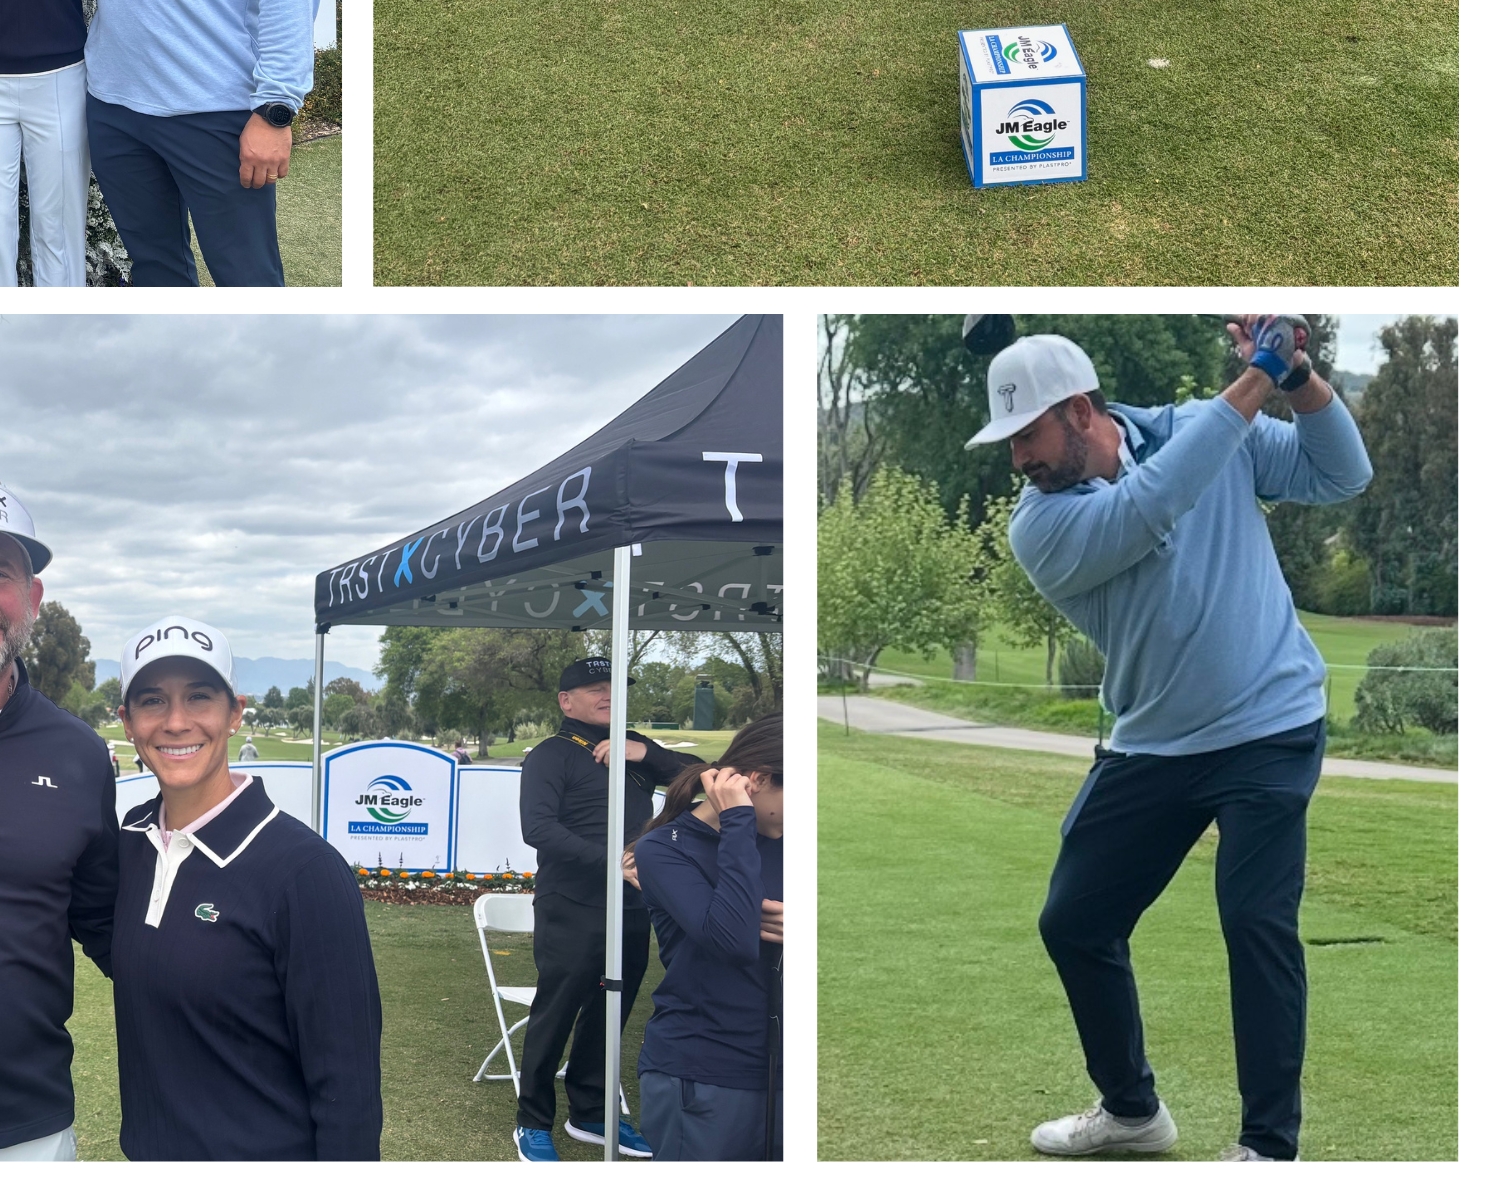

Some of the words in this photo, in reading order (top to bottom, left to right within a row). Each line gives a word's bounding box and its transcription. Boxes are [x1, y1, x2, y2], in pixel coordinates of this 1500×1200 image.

[995, 121, 1020, 135] JM
[1022, 118, 1068, 135] Eagle
[1004, 150, 1072, 162] CHAMPIONSHIP
[135, 625, 214, 661] ping
[355, 794, 378, 806] JM
[380, 794, 423, 808] Eagle
[362, 825, 426, 833] CHAMPIONSHIP
